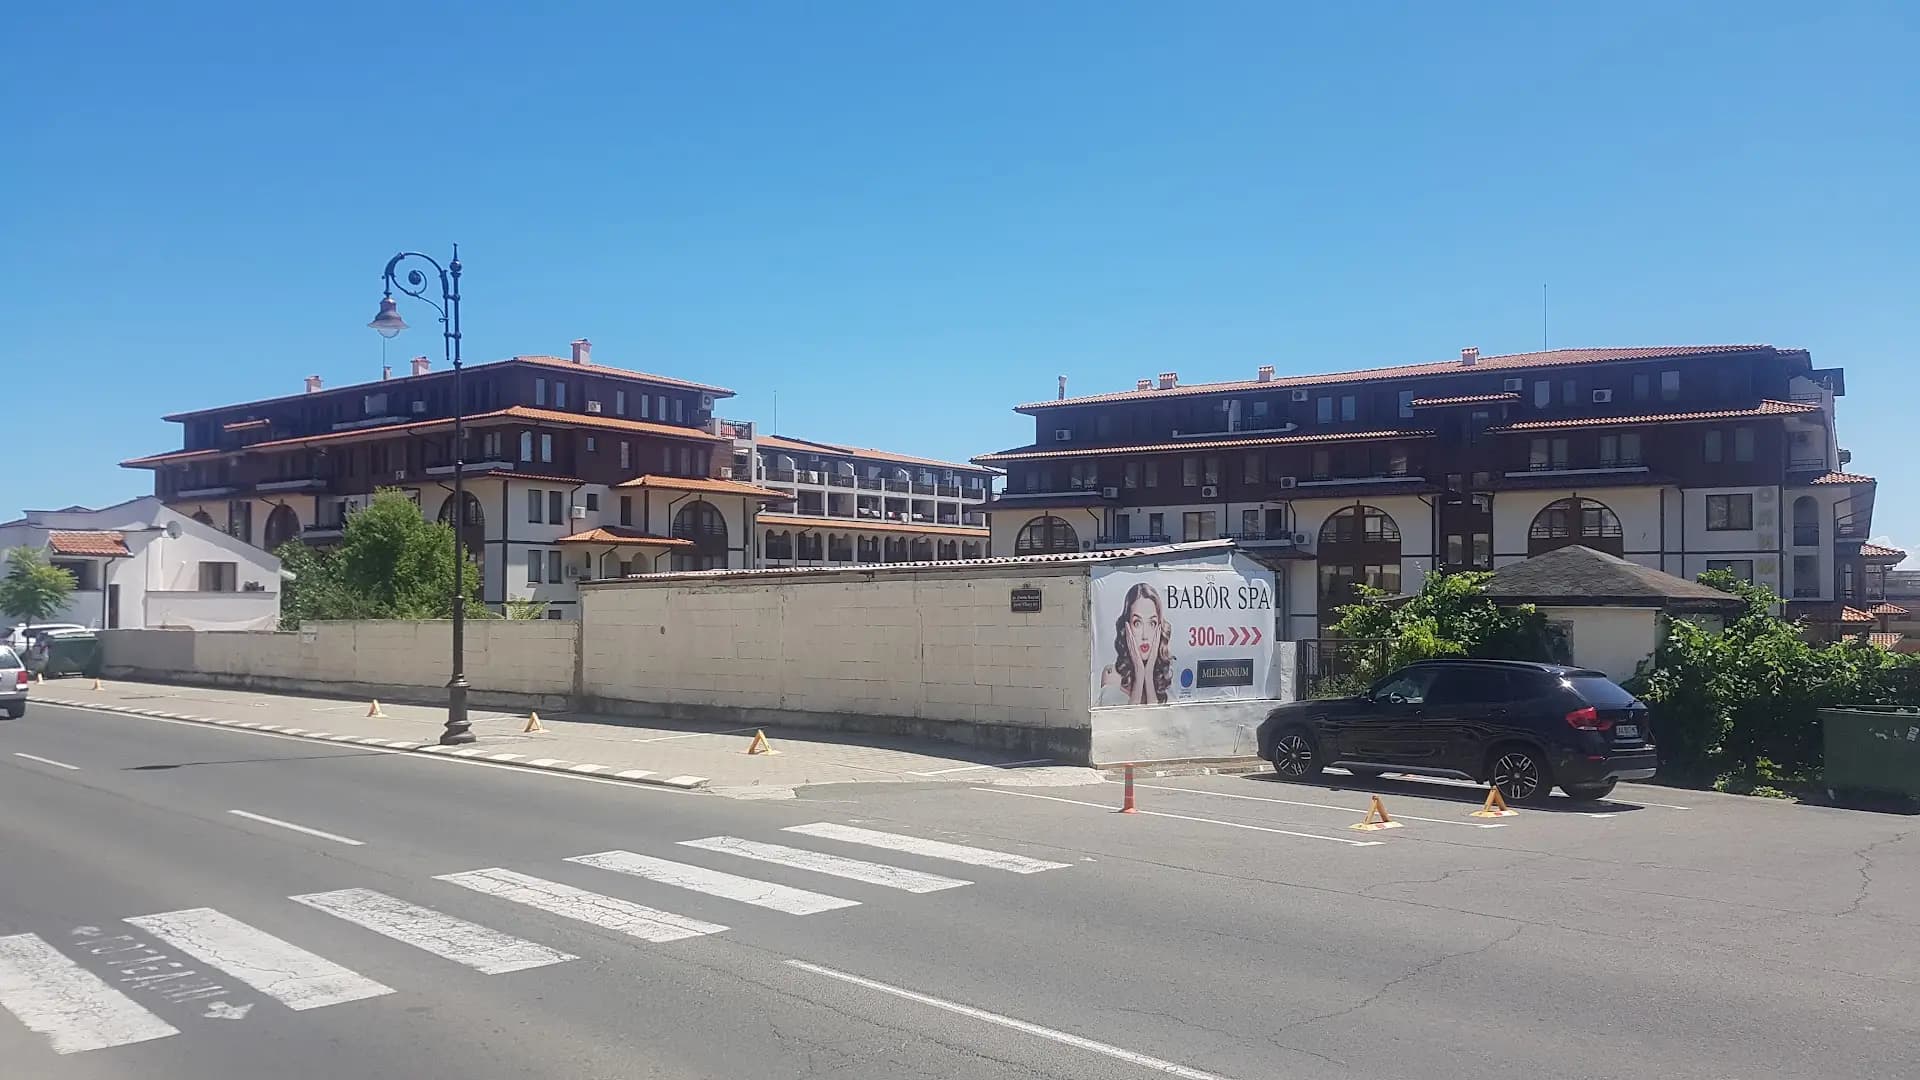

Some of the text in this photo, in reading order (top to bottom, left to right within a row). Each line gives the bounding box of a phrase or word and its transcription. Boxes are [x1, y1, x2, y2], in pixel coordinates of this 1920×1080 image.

[1238, 586, 1271, 610] SPA
[1188, 626, 1225, 647] 300m
[1202, 666, 1249, 679] MILLENNIUM
